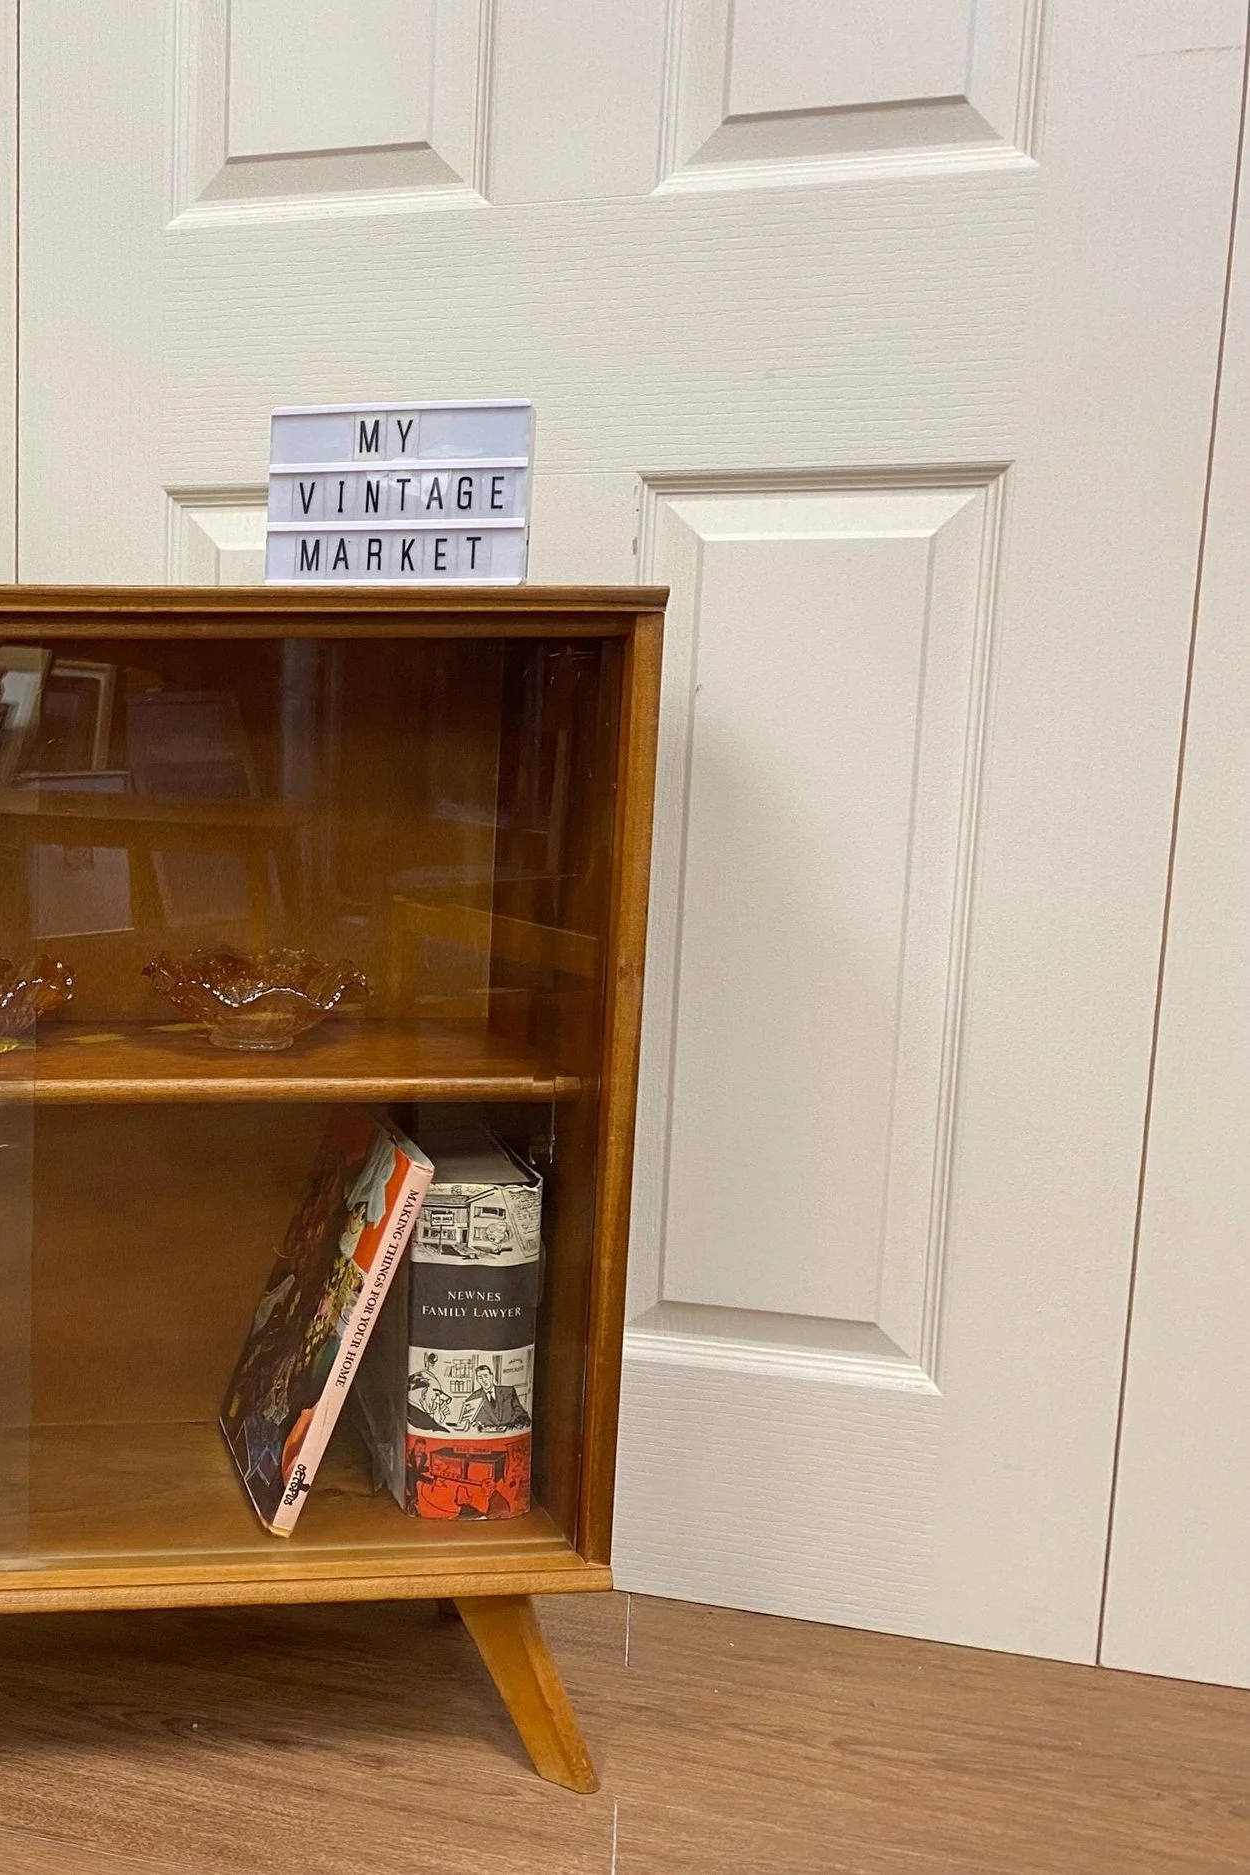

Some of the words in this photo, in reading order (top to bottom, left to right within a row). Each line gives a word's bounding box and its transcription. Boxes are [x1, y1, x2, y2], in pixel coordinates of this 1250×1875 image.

[358, 419, 414, 453] MY
[299, 476, 505, 514] VINTAGE
[299, 536, 482, 571] MARKET
[392, 1189, 419, 1240] MAKING
[373, 1243, 399, 1289] THINGS
[363, 1290, 380, 1314] FOR
[422, 1305, 468, 1317] FAMILY
[473, 1306, 522, 1318] LAWYER
[447, 1290, 501, 1302] NEWNES
[349, 1316, 370, 1349] YOUR
[335, 1350, 357, 1388] HOME
